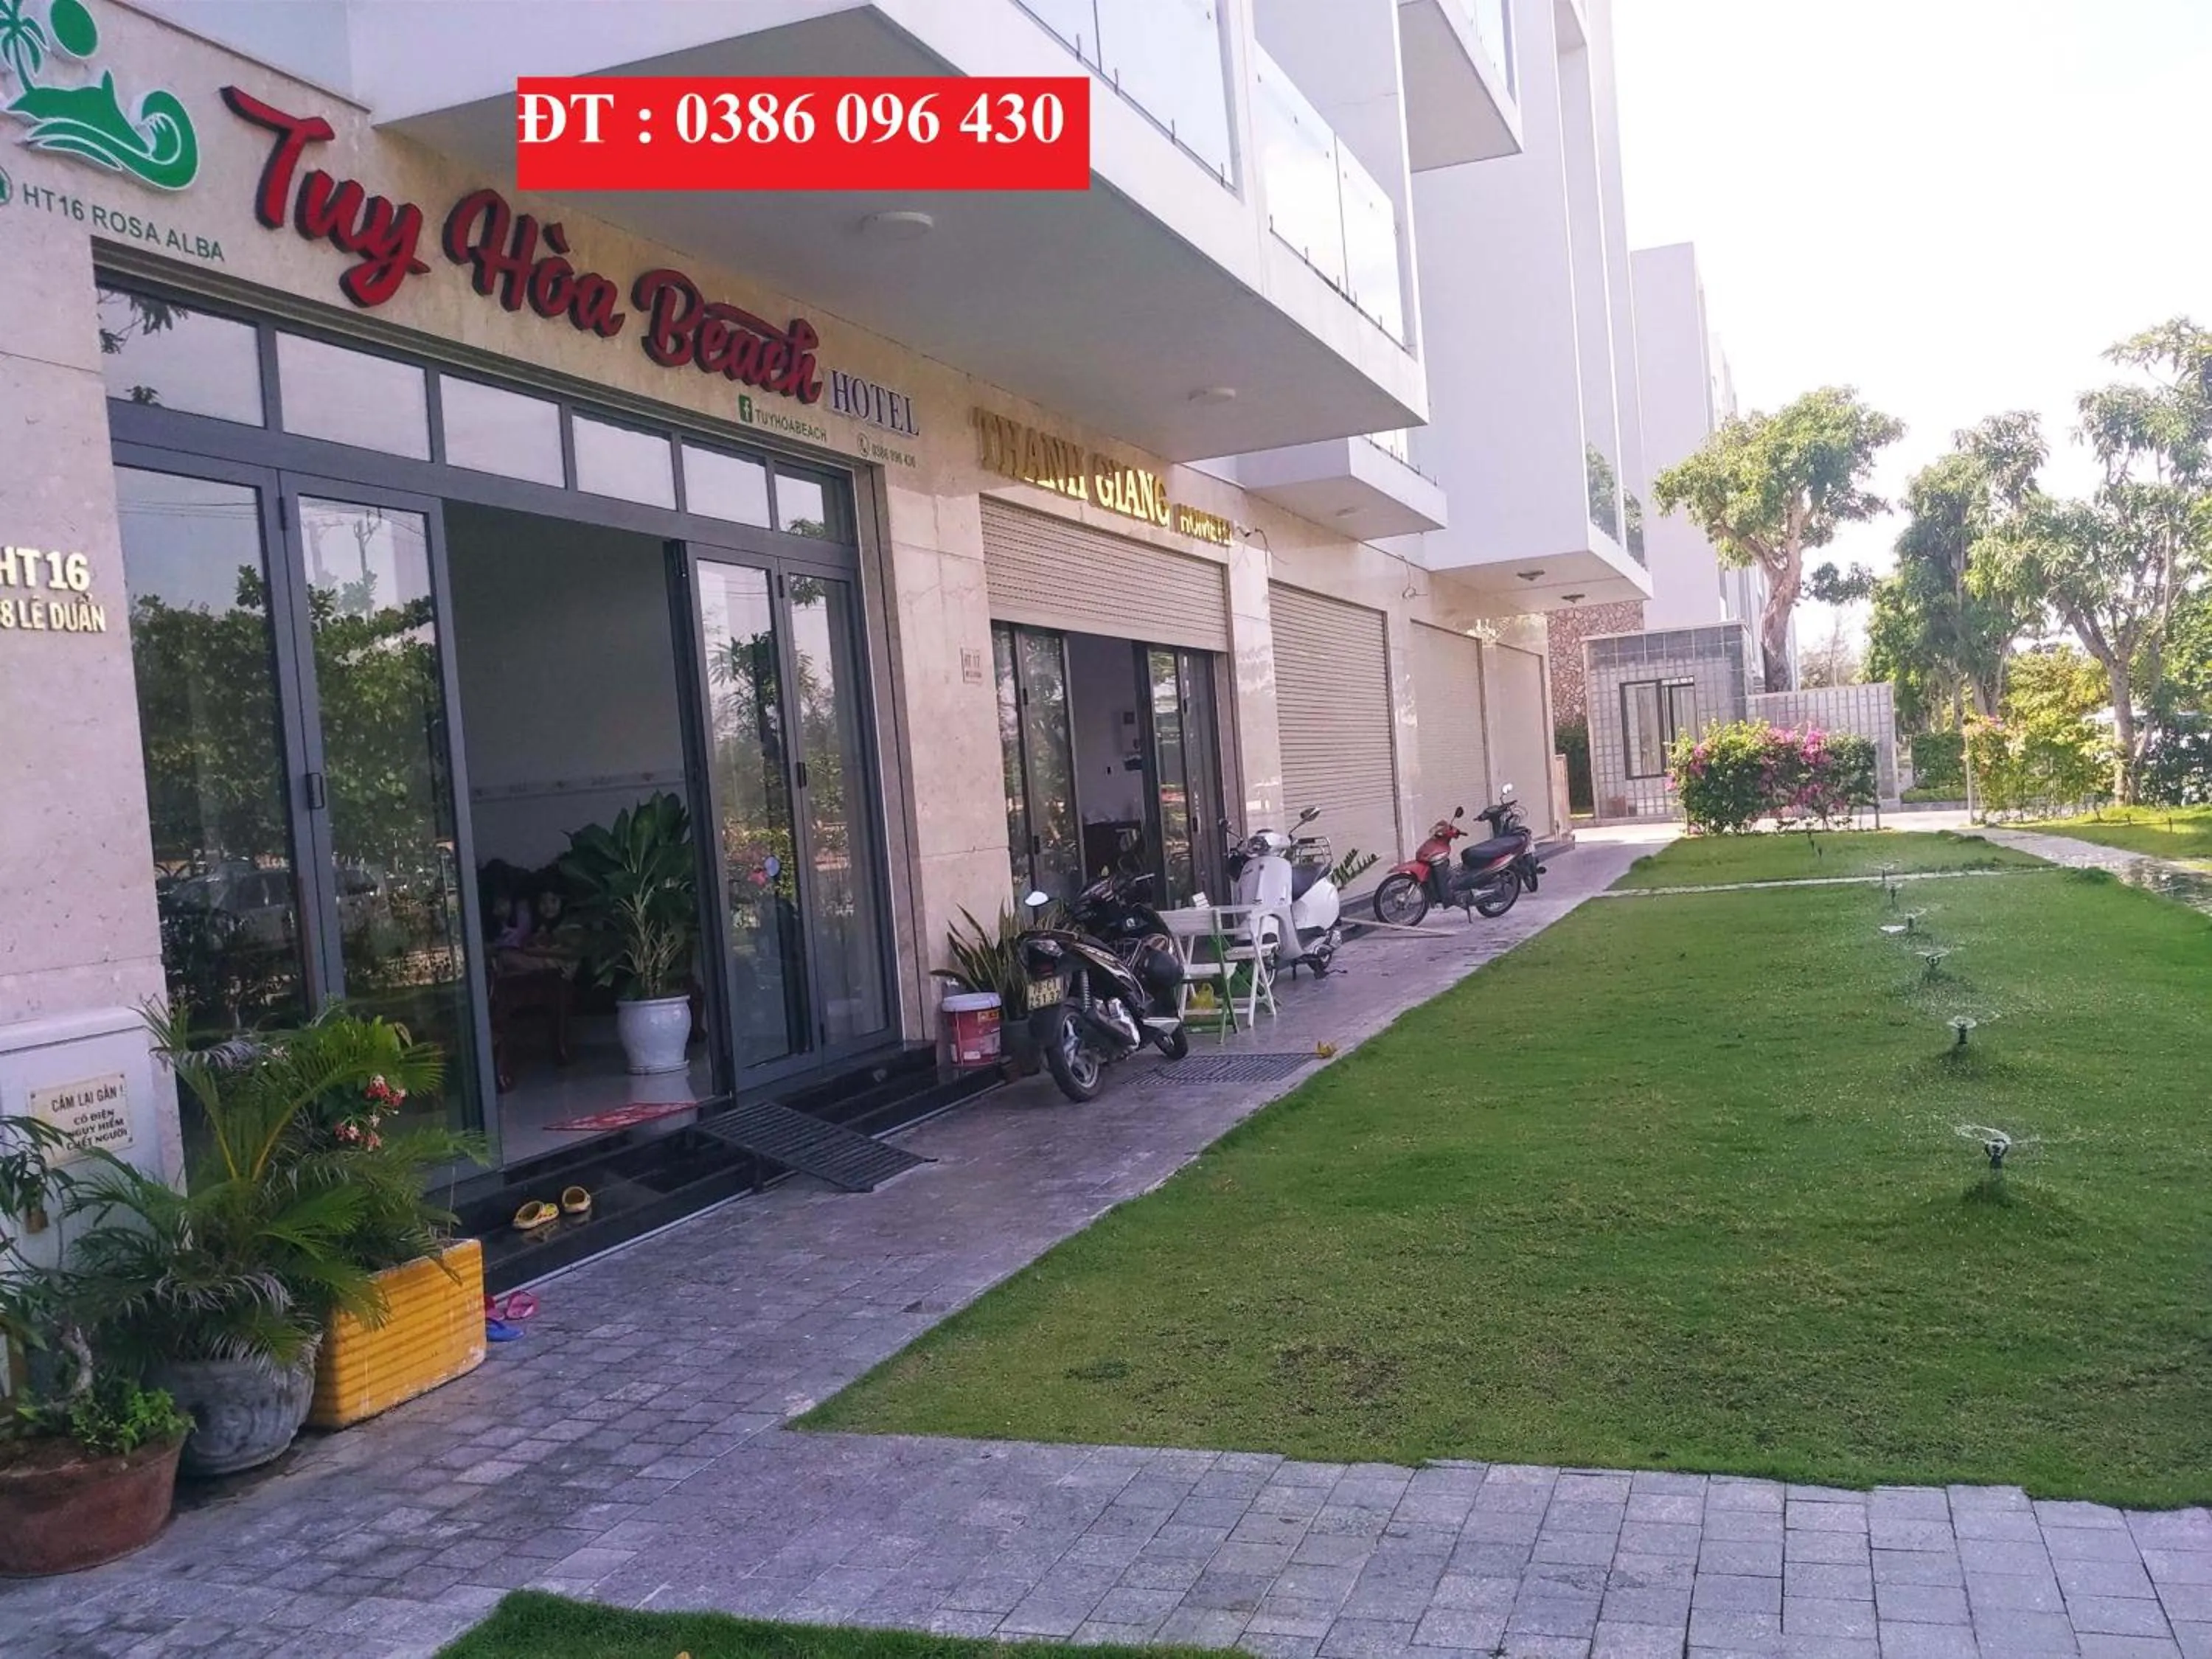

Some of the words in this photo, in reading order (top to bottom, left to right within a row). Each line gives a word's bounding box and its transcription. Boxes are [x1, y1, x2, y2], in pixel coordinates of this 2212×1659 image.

[23, 183, 85, 221] HT16
[91, 205, 161, 245] ROSA
[166, 229, 225, 262] ALBA
[221, 86, 431, 308] Tuy
[442, 188, 625, 338] Hòa
[630, 268, 824, 405] Beach
[754, 408, 827, 442] TUYHOABEACH
[830, 369, 920, 437] HOTEL
[970, 406, 1089, 501] THANH
[1091, 451, 1171, 528] GIANG
[45, 550, 90, 592] 16
[17, 595, 44, 630] LÊ
[74, 1113, 88, 1125] CÓ
